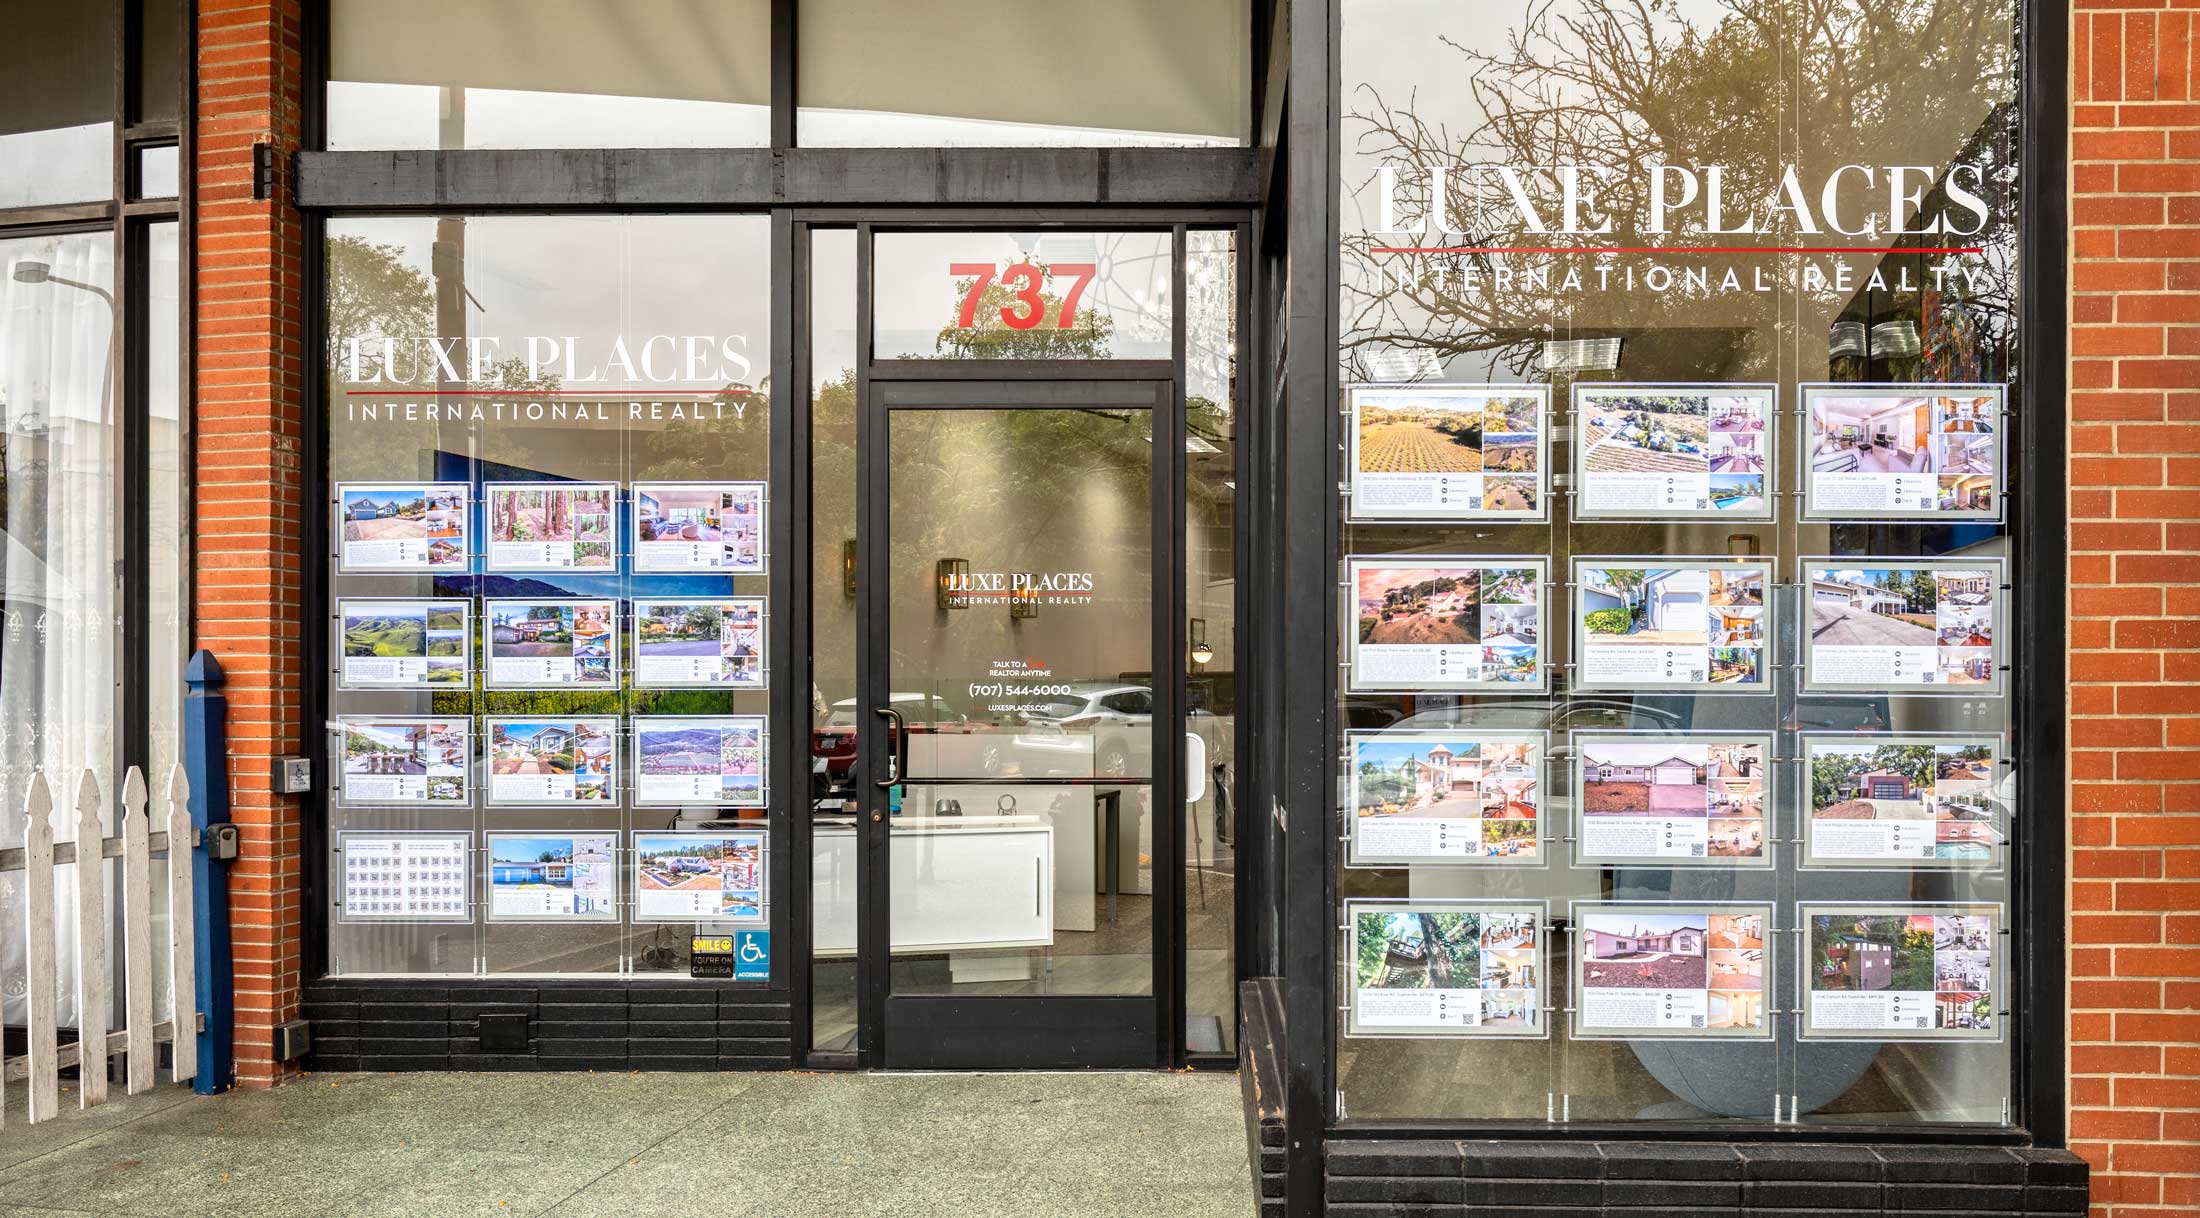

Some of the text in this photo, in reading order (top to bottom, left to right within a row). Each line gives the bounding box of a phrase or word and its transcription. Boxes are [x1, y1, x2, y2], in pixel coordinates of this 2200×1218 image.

[1371, 165, 1989, 236] LUXE PLACES
[1377, 266, 1982, 293] INTERNATIONAL REALTY
[950, 263, 1096, 331] 737
[346, 334, 752, 384] LUXE PLACES
[348, 402, 748, 421] INTERNATIONAL REALTY
[948, 573, 1093, 591] LUXE PLACES
[949, 596, 1092, 605] INTERNATIONAL REALTY
[968, 682, 1072, 698] (707) 544-6000
[692, 939, 720, 951] SMILE
[692, 956, 732, 965] YOU'RE ON
[692, 966, 732, 974] CAMERA
